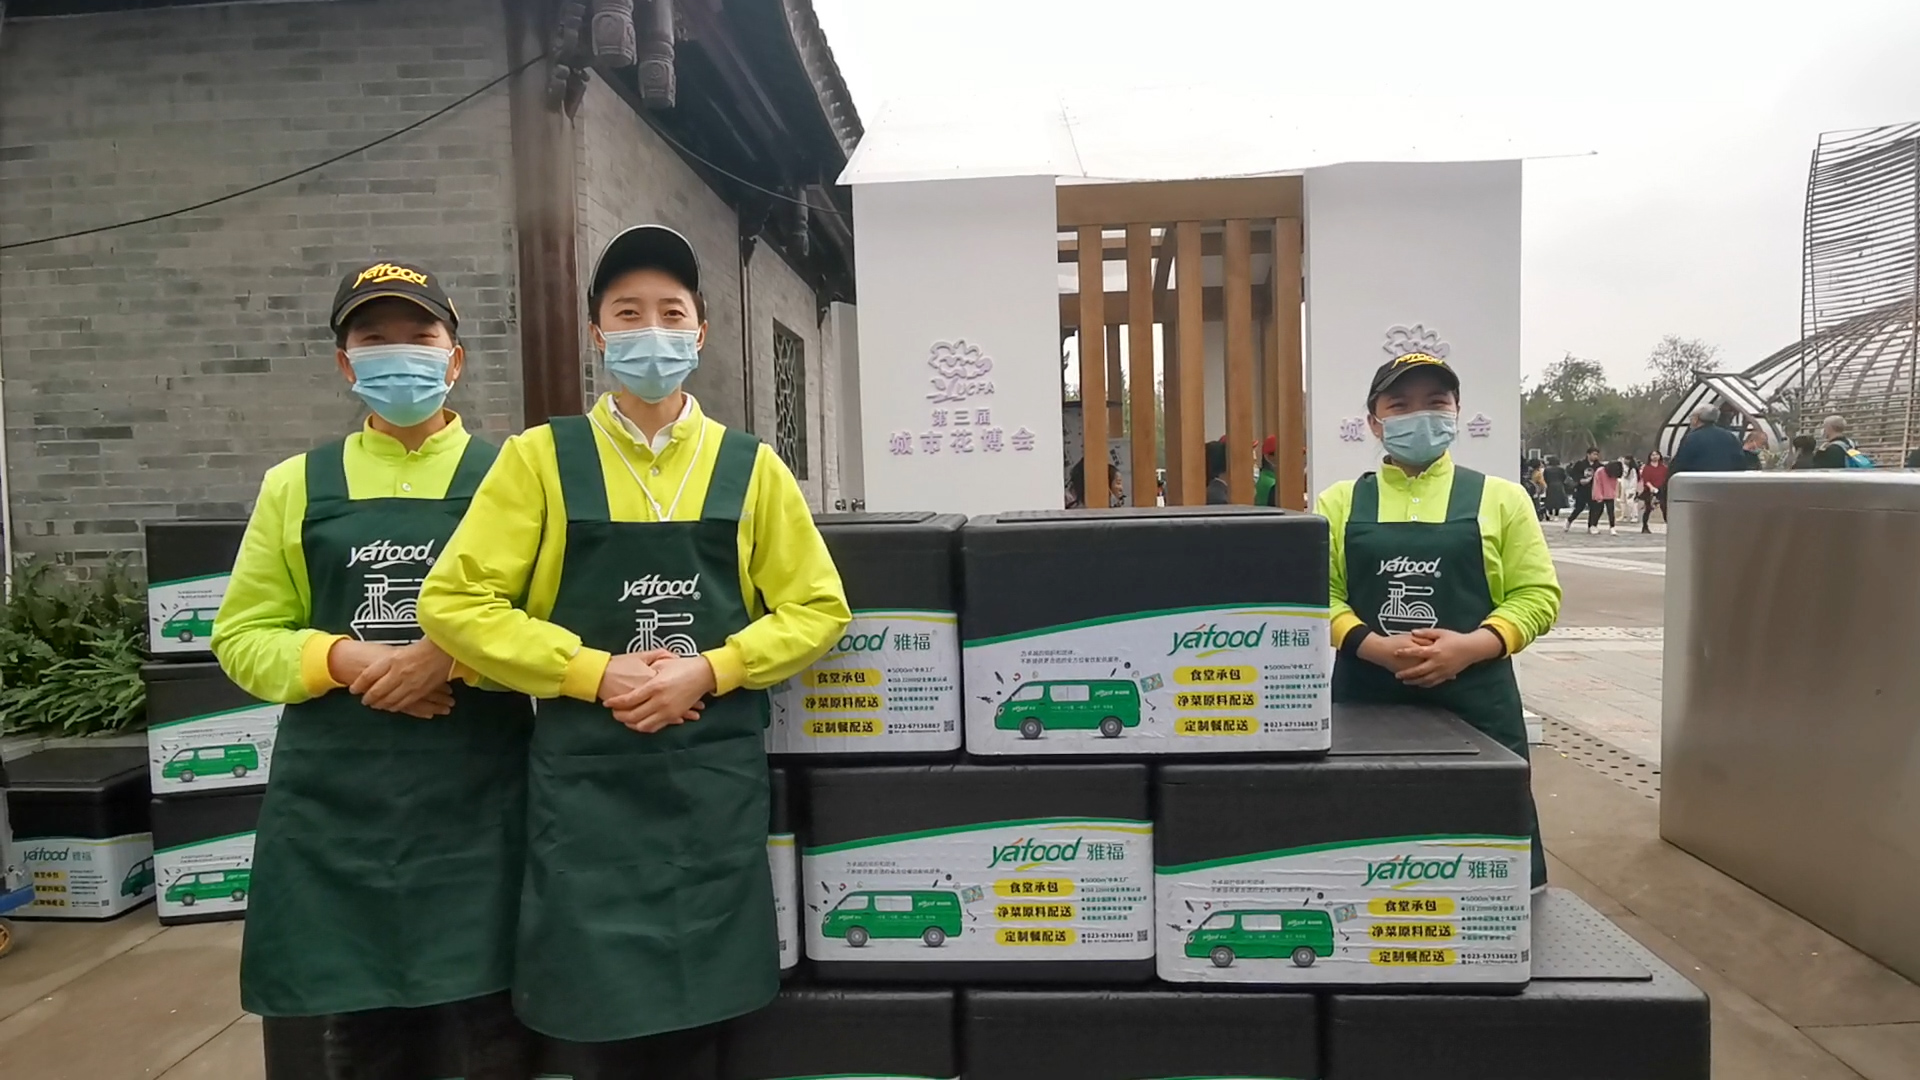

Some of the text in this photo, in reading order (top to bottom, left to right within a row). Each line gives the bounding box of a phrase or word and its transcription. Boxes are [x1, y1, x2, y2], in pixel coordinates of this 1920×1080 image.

[931, 408, 991, 427] 第三届
[889, 427, 1035, 455] 城市花博会
[893, 633, 931, 651] 雅福
[1271, 629, 1310, 647] 雅福
[817, 672, 866, 684] 食堂承包
[1190, 669, 1241, 681] 食堂承包
[805, 696, 879, 709] 净菜原料配送
[1177, 694, 1255, 707] 净菜原料配送
[812, 721, 874, 733] 定制餐配送
[1184, 720, 1249, 732] 定制餐配送
[1087, 843, 1125, 861] 雅福
[1468, 860, 1509, 879] 雅福
[1010, 881, 1058, 893] 食堂承包
[998, 906, 1072, 918] 净菜原料配送
[1385, 900, 1437, 912] 食堂承包
[1005, 931, 1066, 942] 定制餐配送
[1372, 925, 1451, 937] 净菜原料配送
[1379, 950, 1445, 963] 定制餐配送
